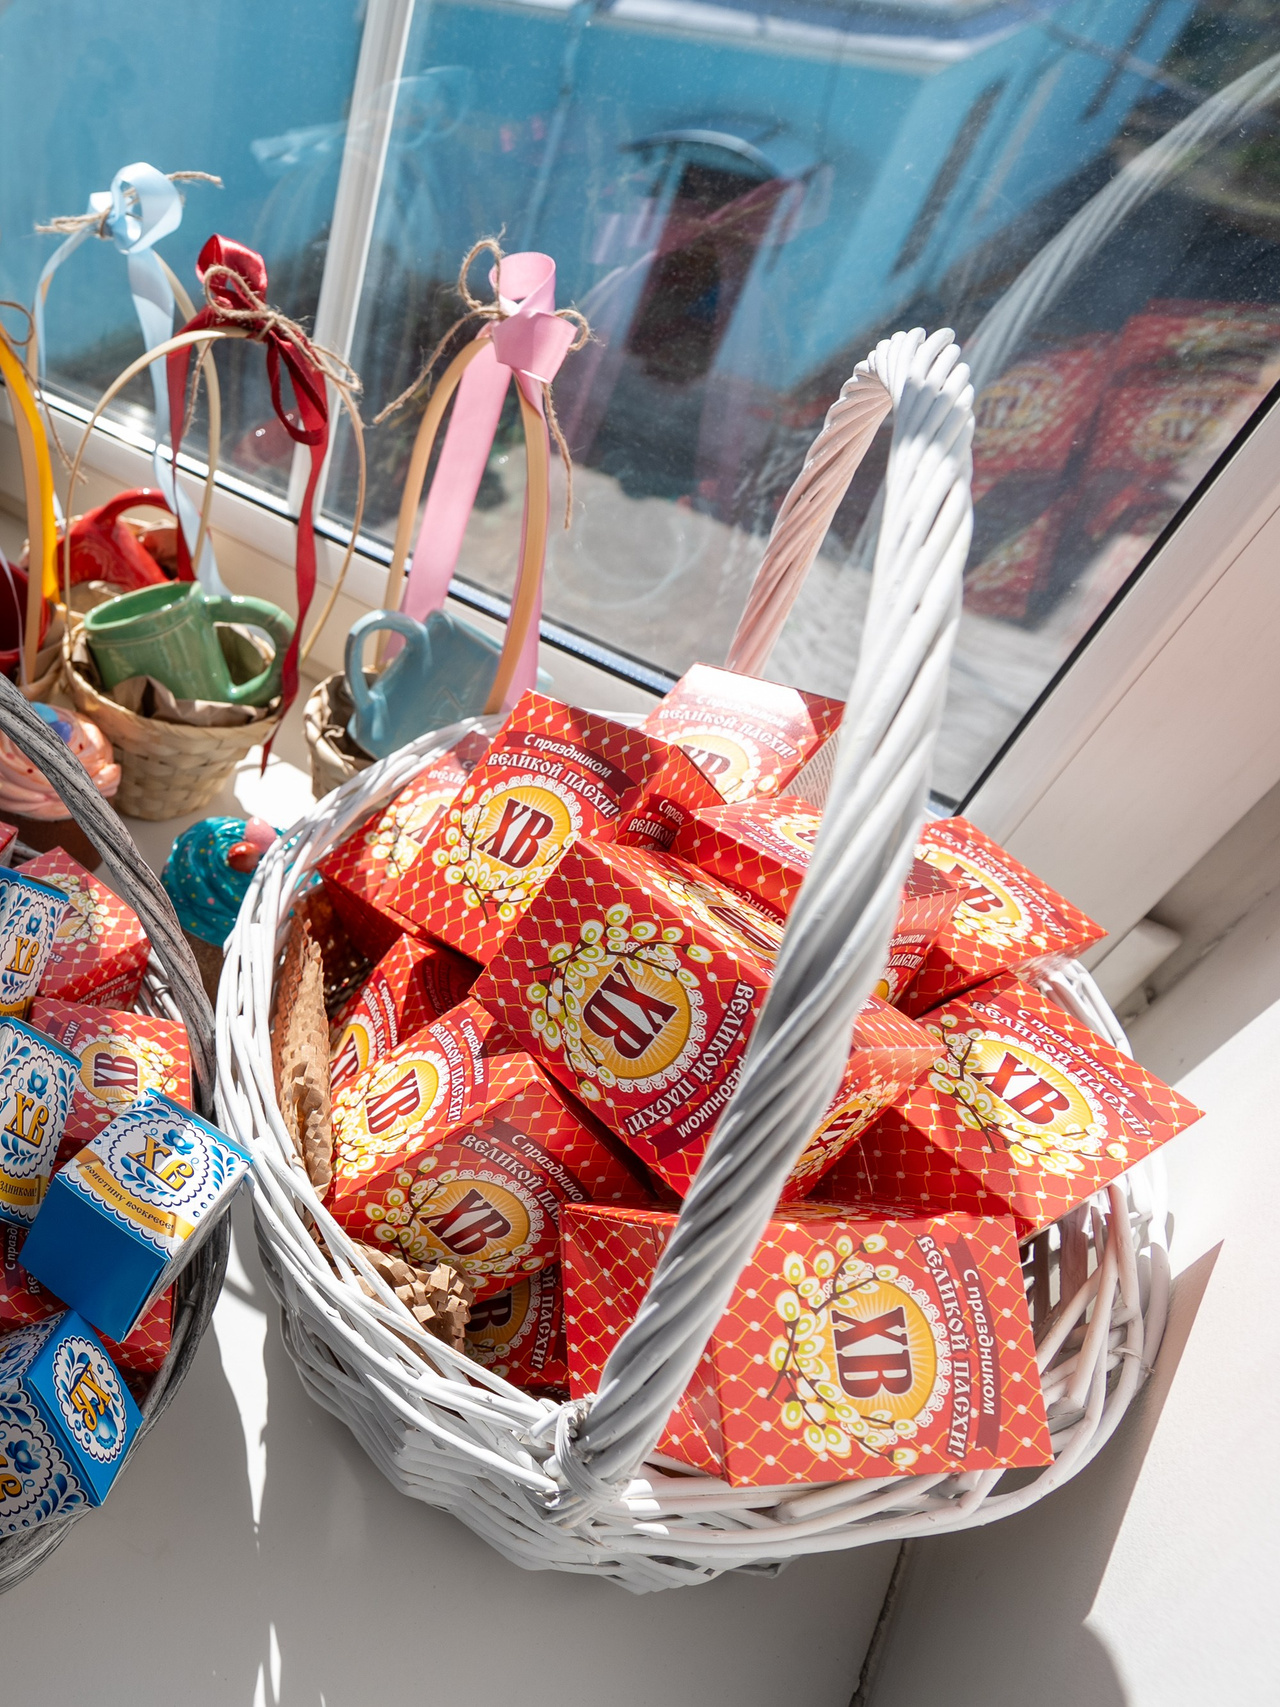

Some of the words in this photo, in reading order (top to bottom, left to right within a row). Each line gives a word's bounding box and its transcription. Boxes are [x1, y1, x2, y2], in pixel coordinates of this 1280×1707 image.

[523, 733, 535, 746] С
[534, 737, 613, 779] праздником
[659, 709, 736, 732] ВЕЛИКОЙ
[738, 722, 798, 760] ПАСХИ!
[486, 752, 563, 780] ВЕЛИКОЙ
[562, 767, 620, 819] ПАСХИ!
[658, 799, 668, 811] С
[477, 798, 554, 869] ХВ
[929, 828, 1008, 884] ВЕЛИКОЙ
[1010, 885, 1067, 938] ПАСХИ!
[976, 847, 1056, 913] праздником
[6, 936, 39, 976] ХВ
[379, 979, 387, 988] С
[62, 1021, 80, 1048] СХИ!
[363, 988, 382, 1029] ВЕЛИКОЙ
[380, 988, 398, 1047] праздником
[460, 1018, 472, 1029] С
[582, 961, 679, 1060] ХВ
[697, 981, 755, 1081] ВЕЛИКОЙ
[94, 1053, 138, 1095] ХВ
[429, 1023, 461, 1068] ВЕЛИКОЙ
[448, 1069, 466, 1122] ПАСХИ!
[462, 1029, 485, 1086] праздником
[970, 1002, 1073, 1068] ВЕЛИКОЙ
[1075, 1065, 1152, 1137] ПАСХИ!
[1017, 1009, 1029, 1021] С
[1028, 1018, 1136, 1100] праздником
[4, 1091, 49, 1148] ХВ
[365, 1068, 422, 1136] ХВ
[625, 1078, 697, 1135] ПАСХИ!
[974, 1052, 1070, 1126] ХВ
[126, 1134, 195, 1191] ХВ
[460, 1133, 543, 1190] ВЕЛИКОЙ
[511, 1134, 521, 1146] С
[520, 1141, 584, 1203] празднико
[85, 1164, 126, 1201] ВОИСТИНУ
[126, 1200, 175, 1231] ВОСКРЕСЕ!
[420, 1188, 512, 1257] ХВ
[7, 1226, 19, 1260] празд
[963, 1269, 979, 1282] С
[532, 1296, 555, 1370] ПАСХИ!
[831, 1306, 914, 1398] ХВ
[920, 1236, 970, 1351] ВЕЛИКОЙ
[949, 1360, 971, 1458] ПАСХИ!
[967, 1286, 996, 1415] праздником
[70, 1362, 112, 1431] ХВ
